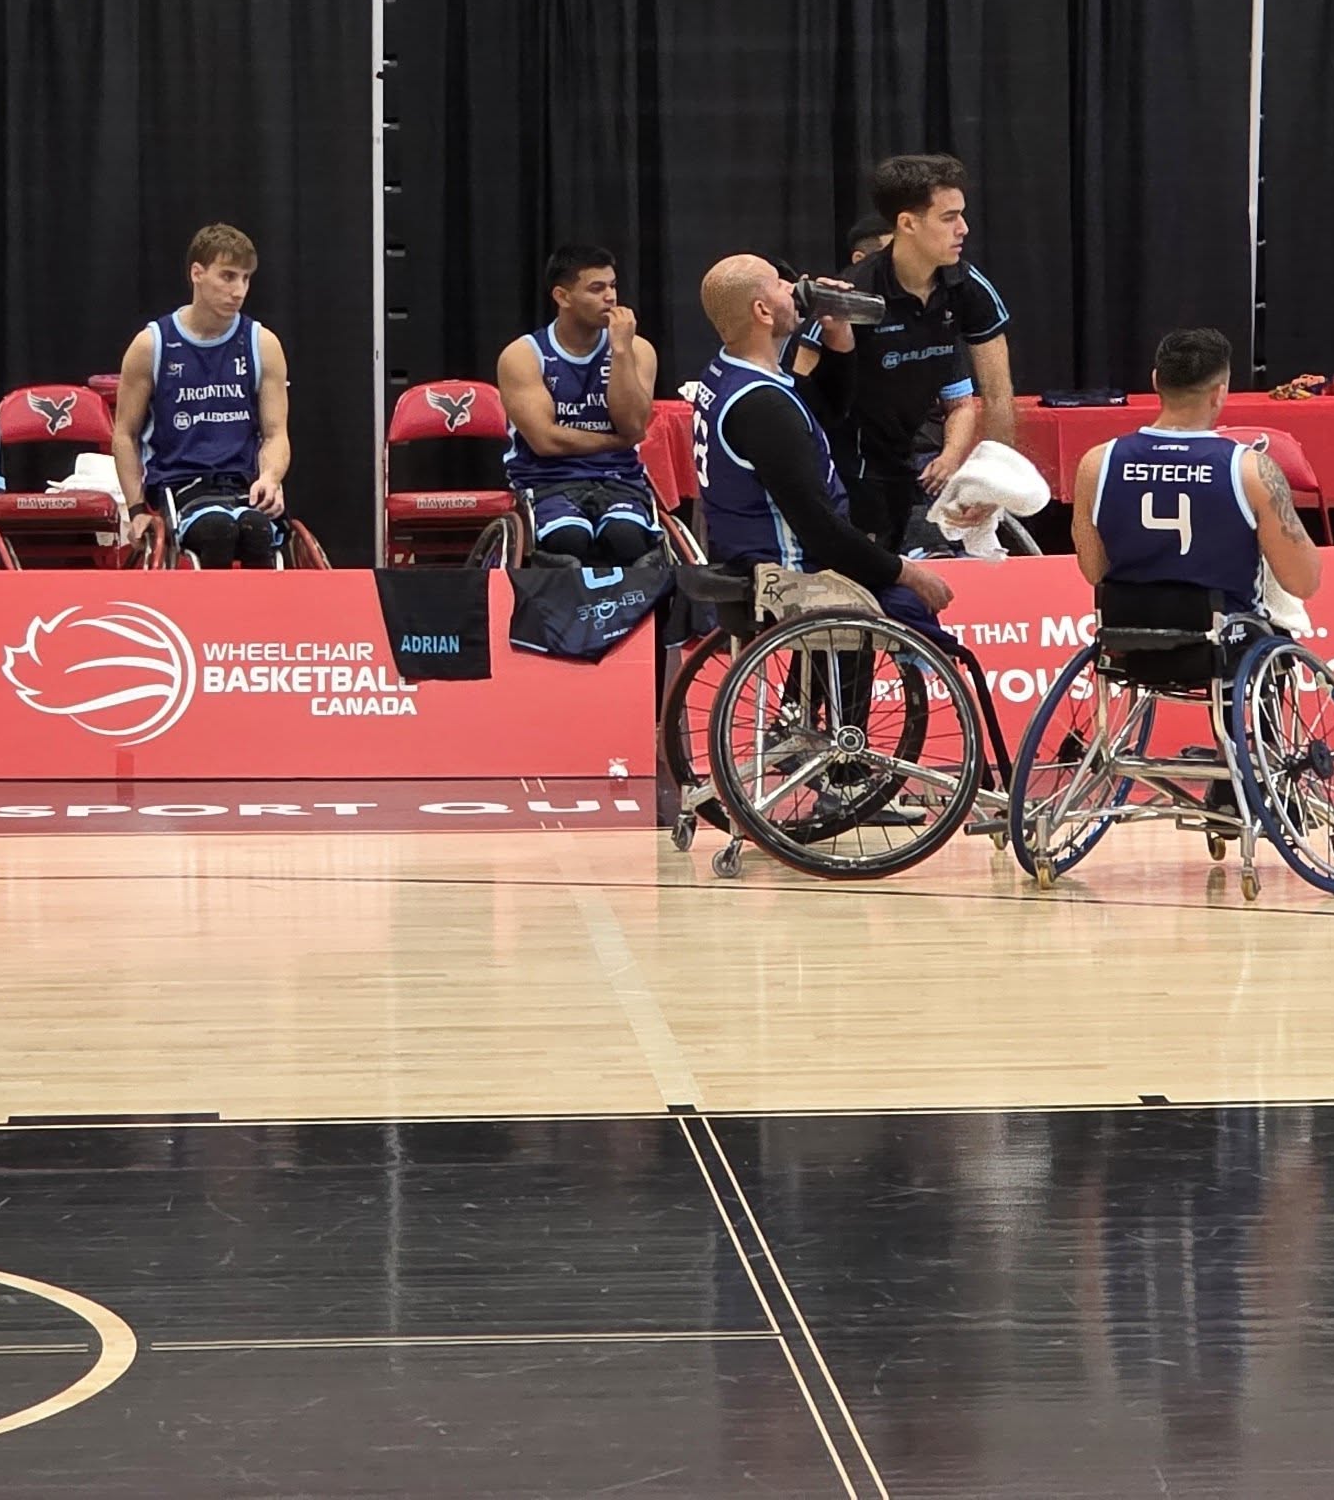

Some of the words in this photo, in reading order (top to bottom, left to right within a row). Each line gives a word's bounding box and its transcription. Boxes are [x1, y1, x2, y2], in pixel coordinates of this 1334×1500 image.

[1123, 463, 1213, 483] ESTECHE
[1141, 492, 1192, 555] 4
[971, 622, 1029, 645] THAT
[203, 642, 374, 661] WHEELCHAIR
[401, 635, 460, 653] ADRIAN
[311, 696, 418, 716] CANADA
[418, 799, 641, 815] QUI
